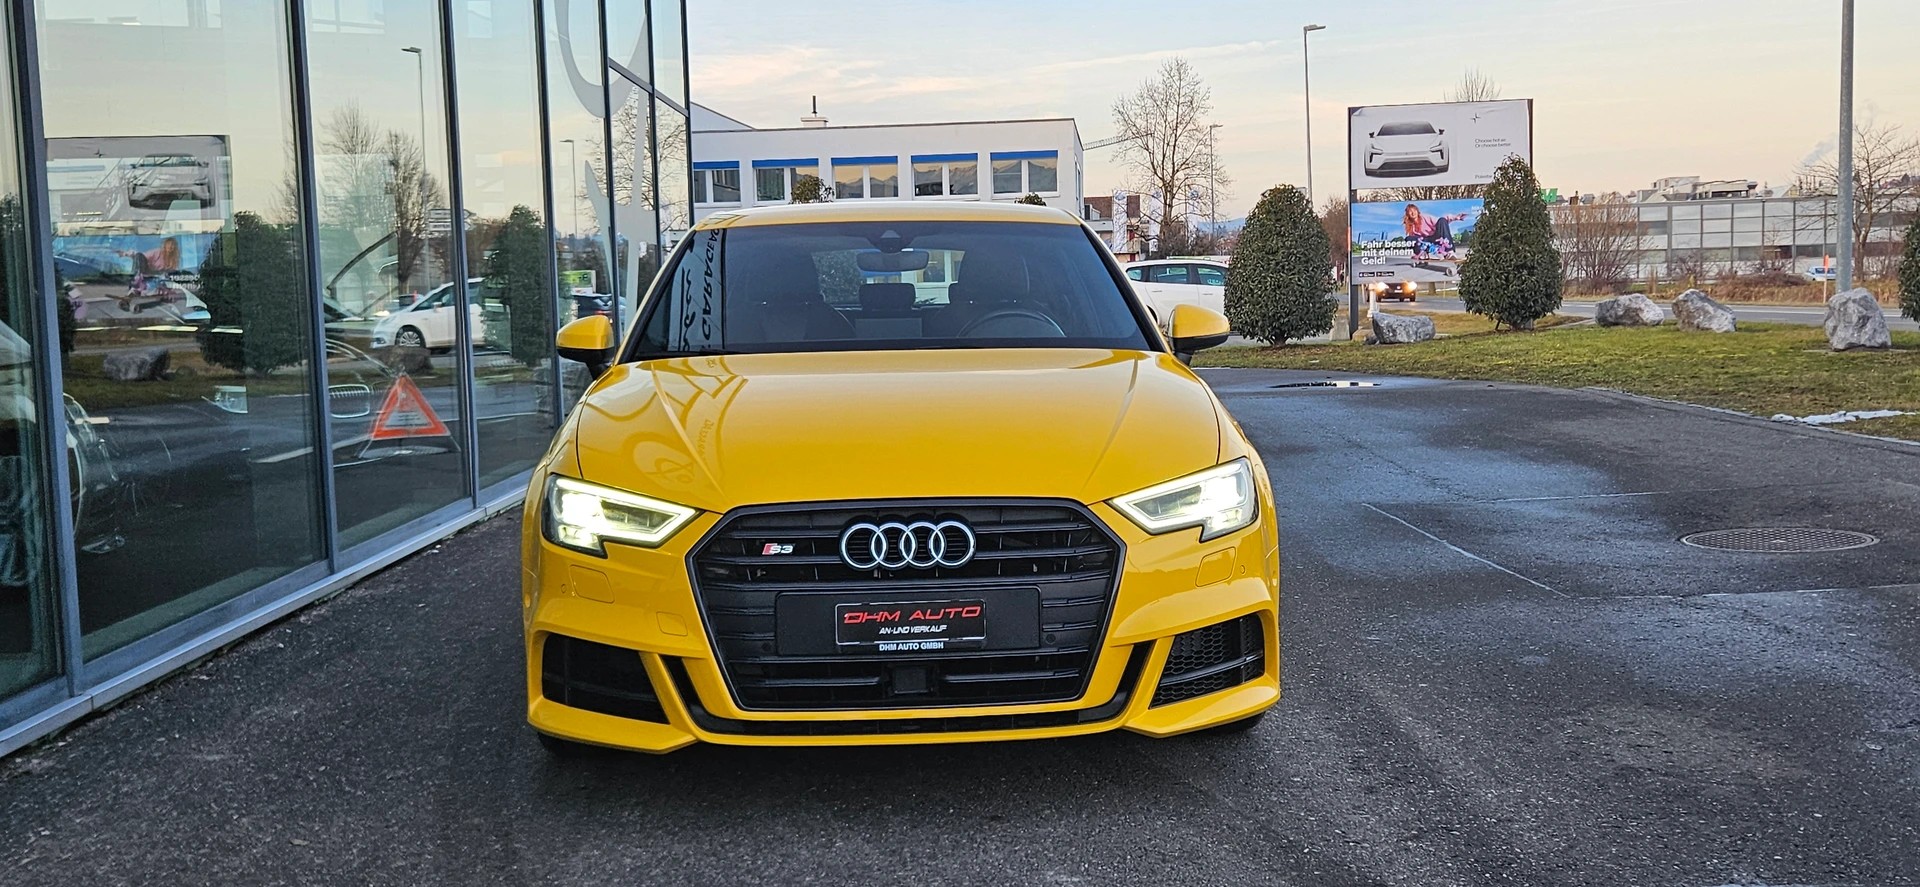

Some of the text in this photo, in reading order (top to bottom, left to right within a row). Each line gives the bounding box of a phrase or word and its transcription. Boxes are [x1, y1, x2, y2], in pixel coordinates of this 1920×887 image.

[1361, 240, 1416, 248] Fahr besser
[1361, 248, 1414, 257] mit deinem
[1361, 256, 1386, 265] Geld!
[769, 545, 794, 554] S3
[844, 606, 982, 624] DHM AUTO
[879, 625, 948, 635] AN-UND VERKAUF
[879, 643, 897, 651] DHM
[921, 642, 944, 650] GMBH
